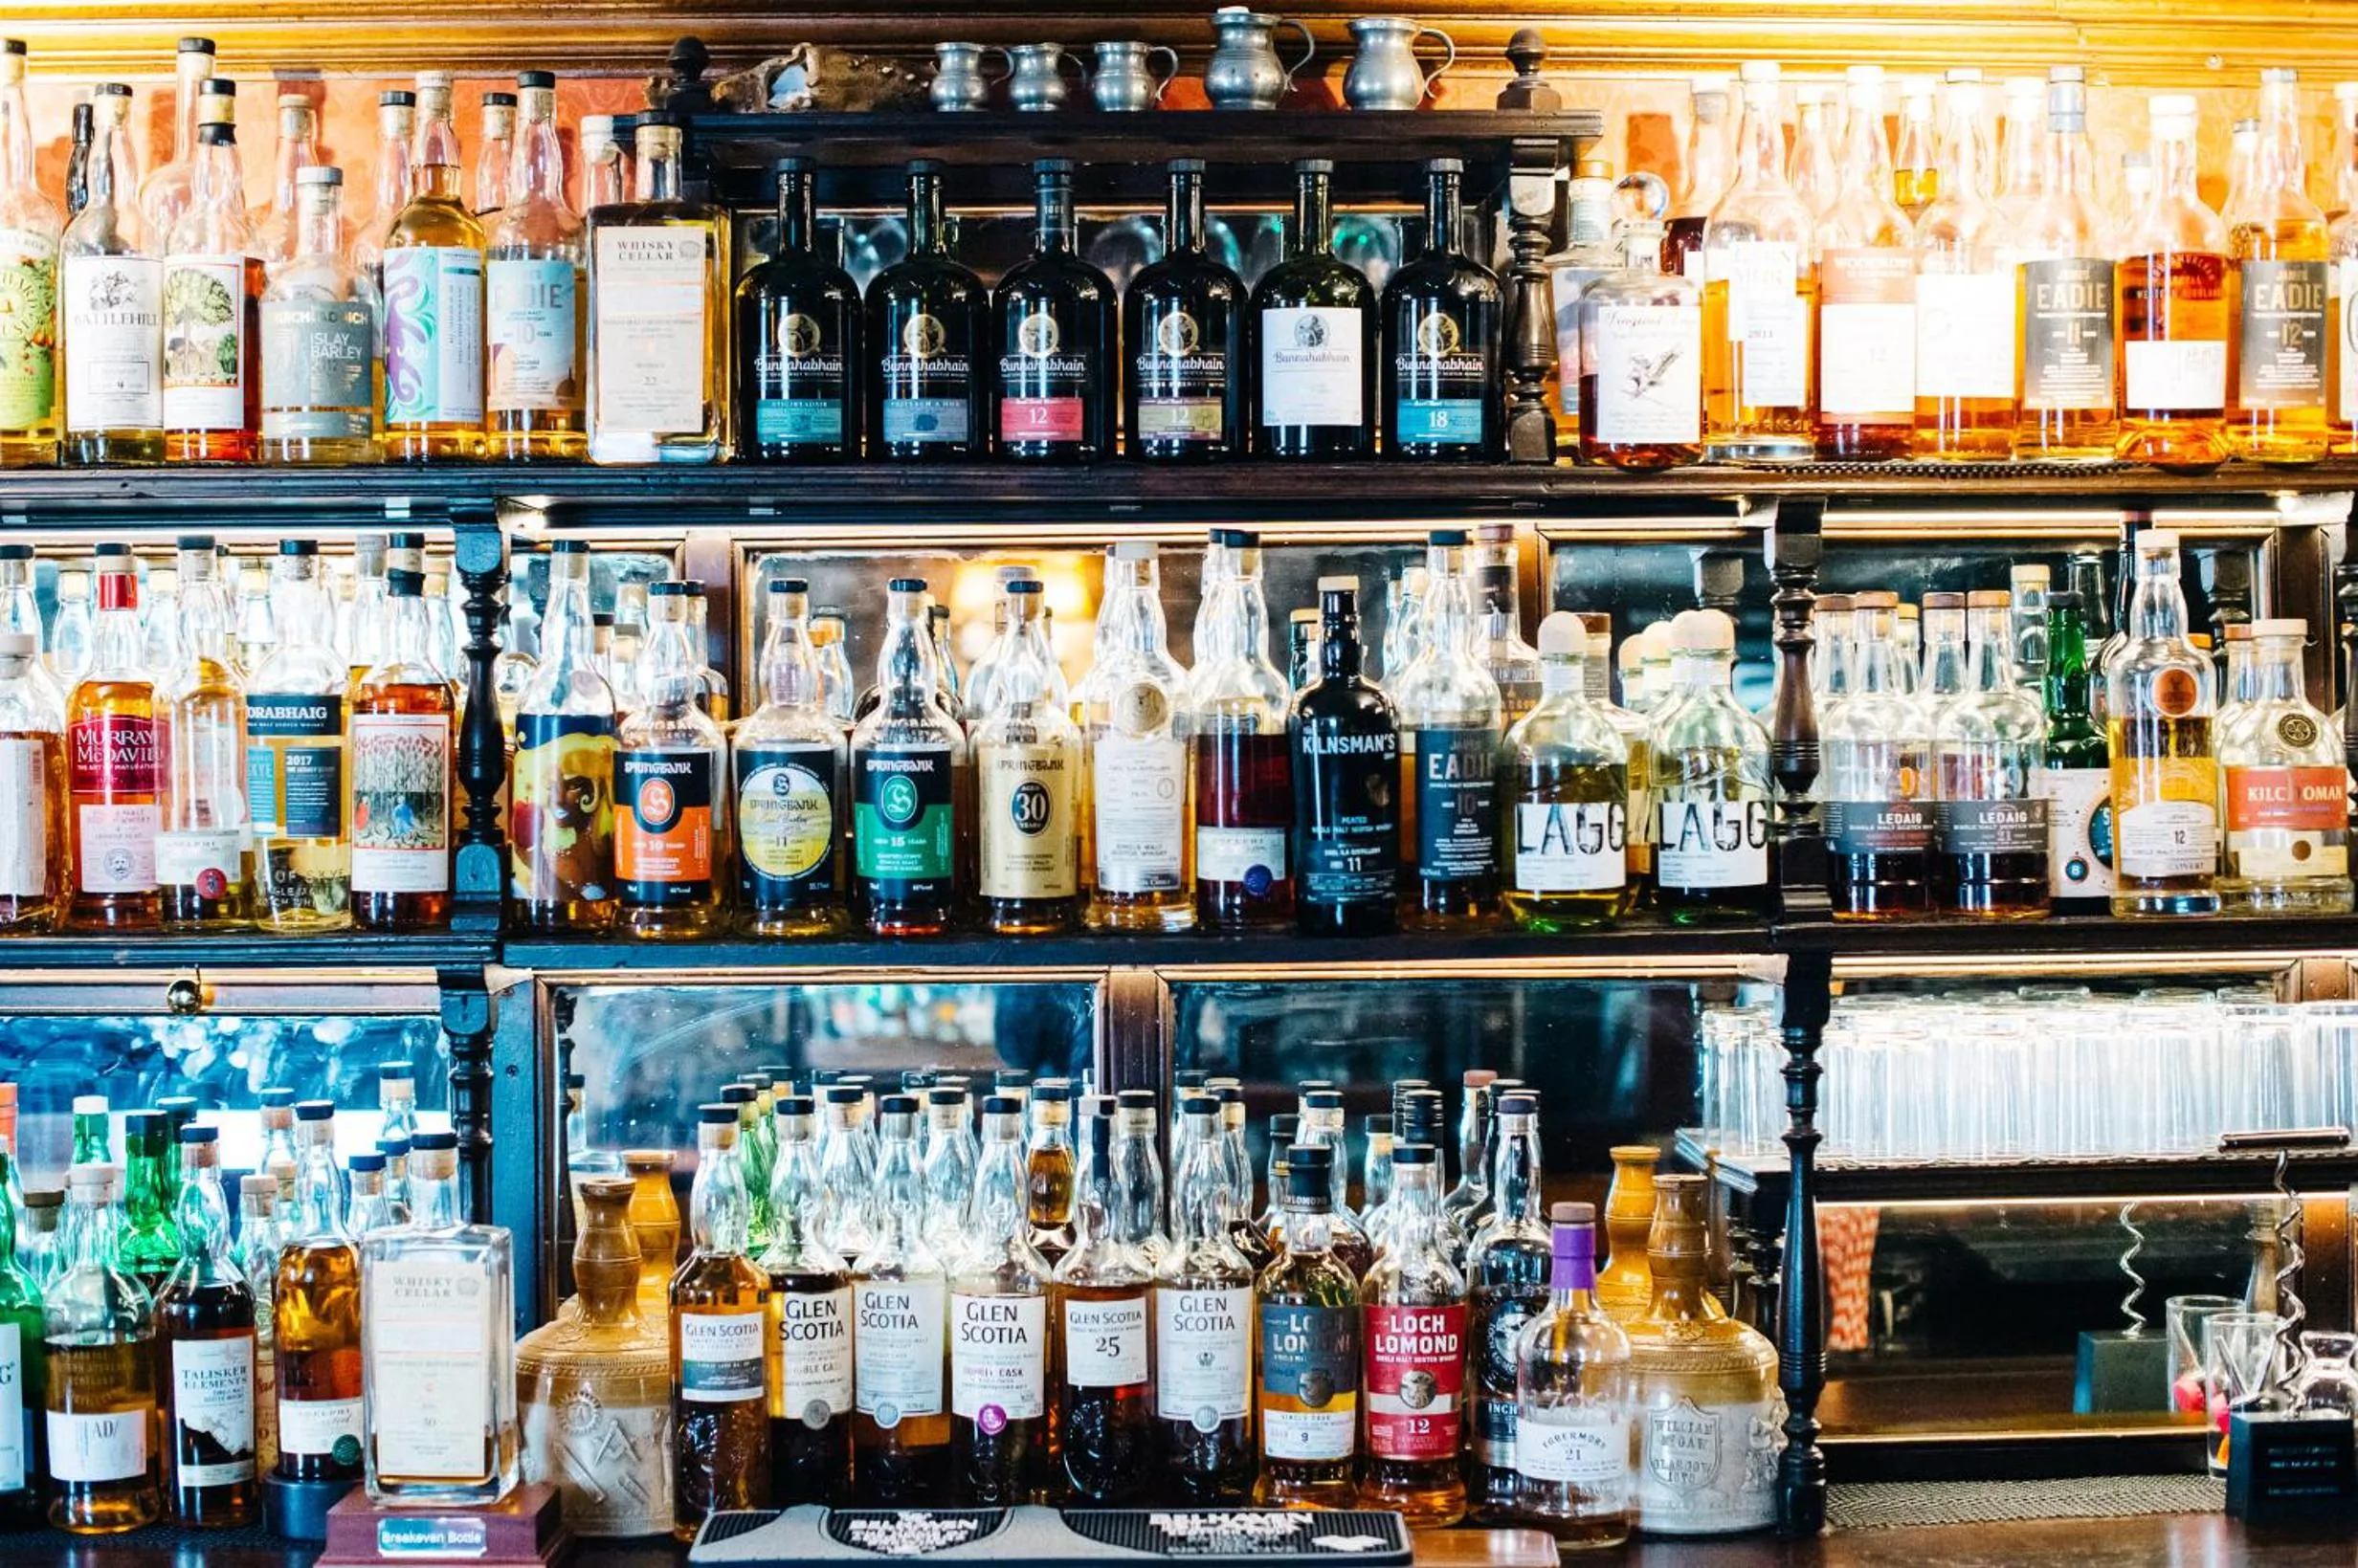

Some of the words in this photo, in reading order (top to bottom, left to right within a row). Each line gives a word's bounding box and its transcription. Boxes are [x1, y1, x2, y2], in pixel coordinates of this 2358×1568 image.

[617, 241, 674, 250] WHISKY
[617, 252, 674, 260] CELLAR
[2036, 283, 2107, 310] EADIE
[2254, 283, 2324, 310] EADIE
[310, 332, 350, 345] ISLAY
[2281, 322, 2303, 347] 12
[310, 345, 363, 359] BARLEY
[1030, 406, 1049, 425] 12
[1168, 407, 1190, 424] 12
[1429, 409, 1449, 430] 18
[247, 706, 327, 719] ORABHAIG
[77, 728, 155, 746] MURRAY
[286, 755, 313, 766] 2017
[997, 759, 1065, 771] PRINGBANK
[2247, 785, 2344, 802] KILCOMAN
[1015, 792, 1047, 822] 30
[1878, 812, 1923, 825] LEDAIG
[1979, 811, 2028, 825] LEDAIG
[2173, 829, 2186, 845] 12
[1346, 856, 1362, 872] 11
[392, 1275, 454, 1287] WHISKY
[393, 1287, 454, 1298] CELLAR
[785, 1298, 837, 1320] GLEN
[865, 1292, 910, 1311] GLEN
[1180, 1295, 1227, 1314] GLEN
[860, 1309, 920, 1330] SCOTIA
[967, 1301, 1018, 1323] GLEN
[1070, 1312, 1100, 1325] GLEN
[1102, 1311, 1142, 1325] SCOTIA
[685, 1323, 716, 1336] GLEN
[719, 1322, 759, 1336] SCOTIA
[778, 1319, 845, 1341] SCOTIA
[1173, 1315, 1235, 1332] SCOTIA
[1289, 1314, 1344, 1334] LOH
[1390, 1314, 1445, 1334] LOCH
[961, 1321, 1028, 1345] SCOTIA
[1095, 1335, 1122, 1358] 25
[1273, 1334, 1350, 1354] LOMN
[1374, 1334, 1459, 1355] LOMOND
[181, 1365, 248, 1380] TALISKER
[998, 1367, 1025, 1378] CASK
[1406, 1418, 1431, 1434] 12
[1654, 1420, 1714, 1435] WILLIAM
[1565, 1448, 1582, 1462] 21
[381, 1530, 445, 1544] Breakeven
[447, 1530, 481, 1544] Bottle
